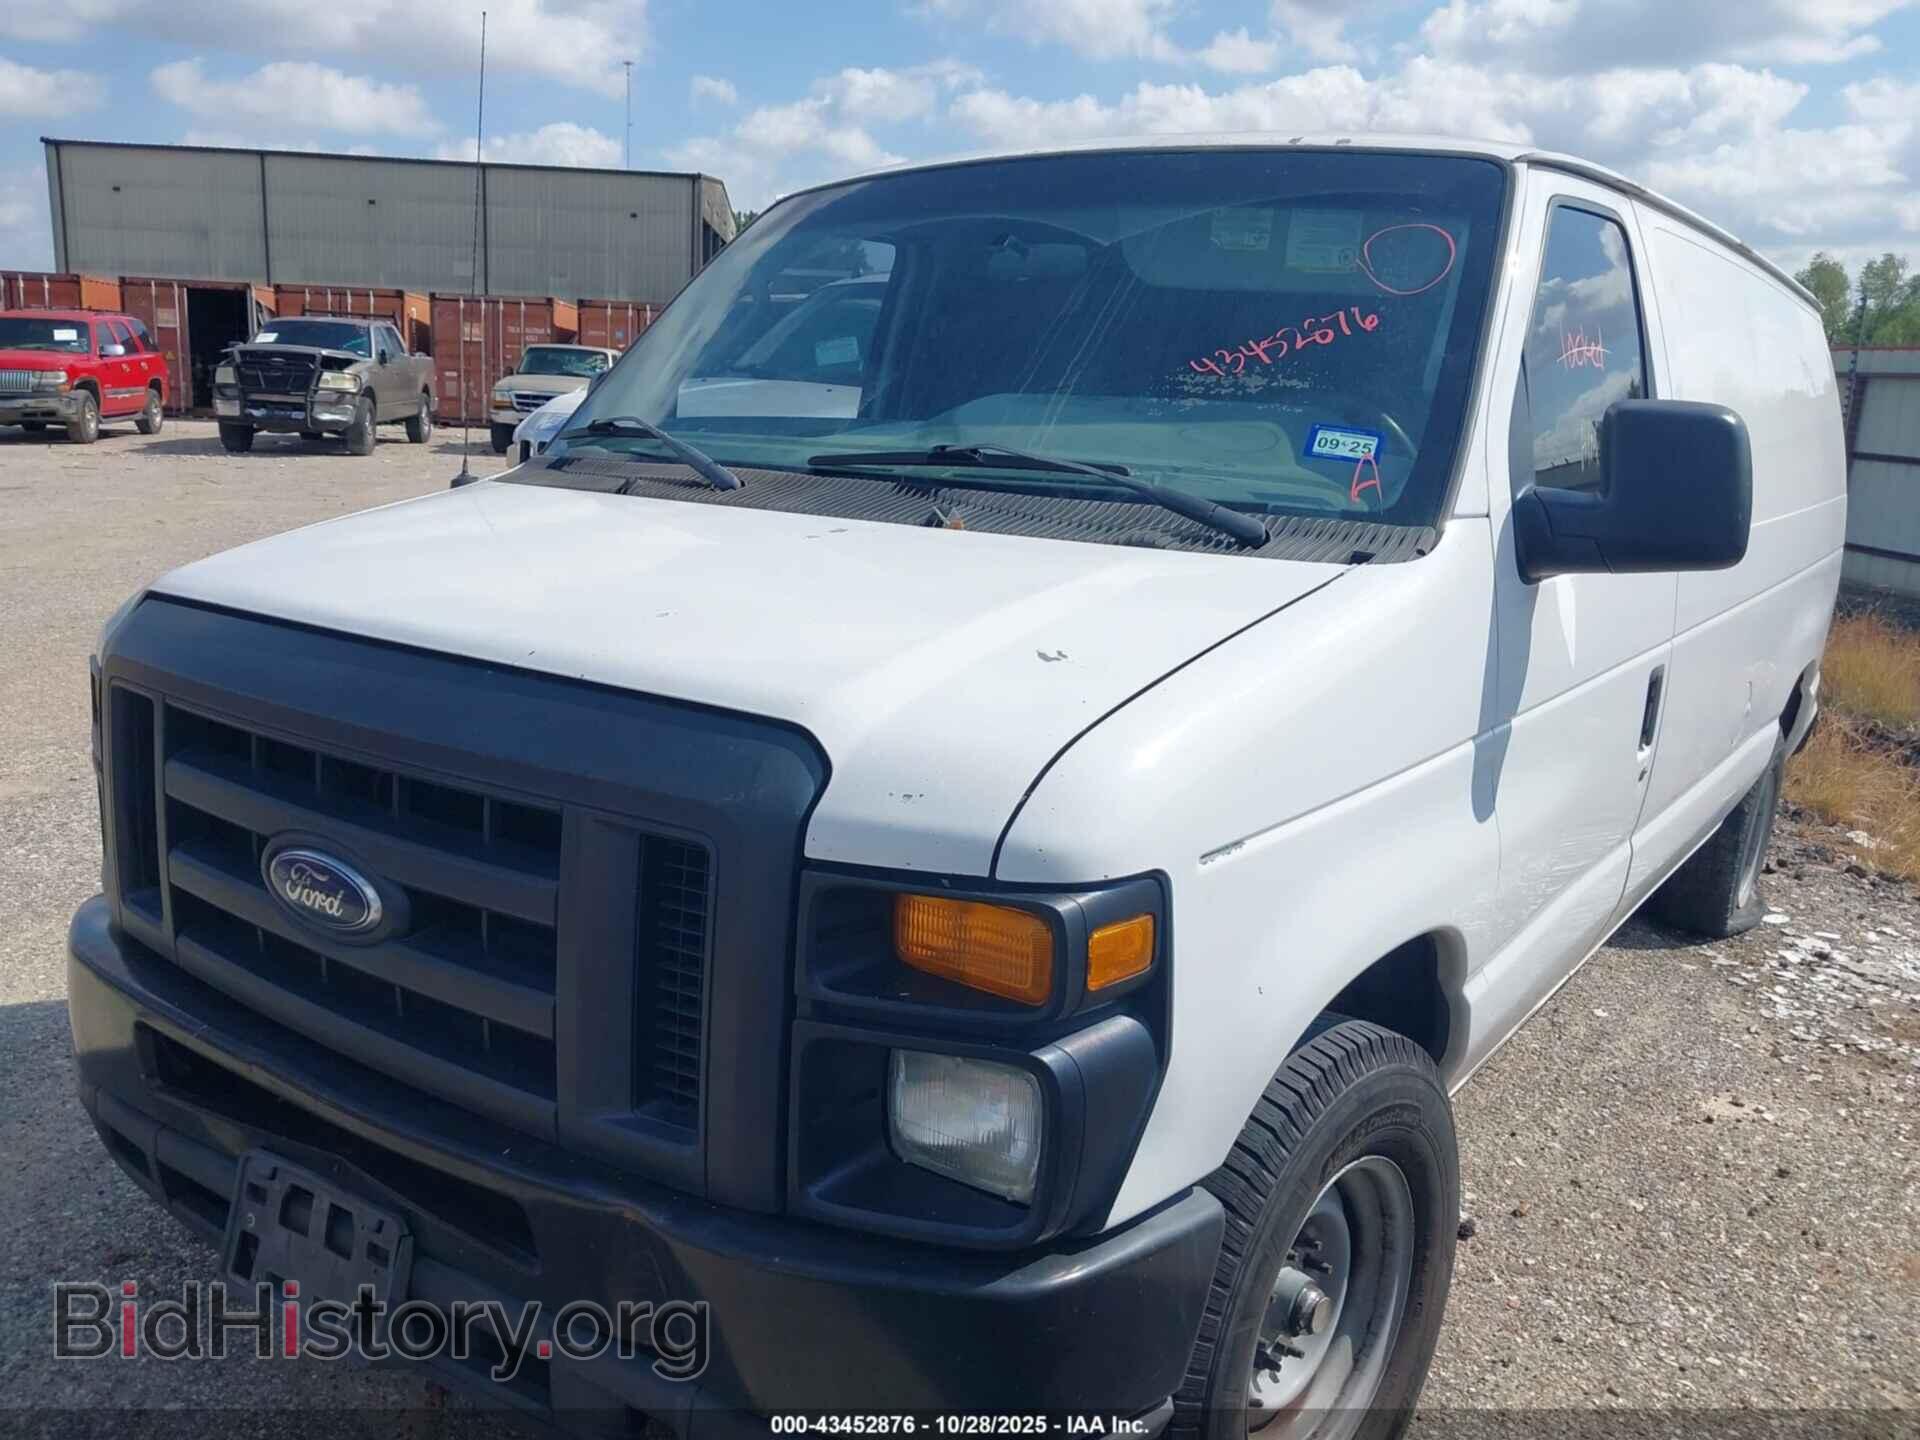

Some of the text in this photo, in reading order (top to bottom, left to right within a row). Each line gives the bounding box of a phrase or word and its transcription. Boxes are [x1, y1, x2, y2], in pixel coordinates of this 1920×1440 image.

[1317, 437, 1373, 454] 09 25
[1350, 453, 1383, 512] A
[286, 863, 345, 917] Ford
